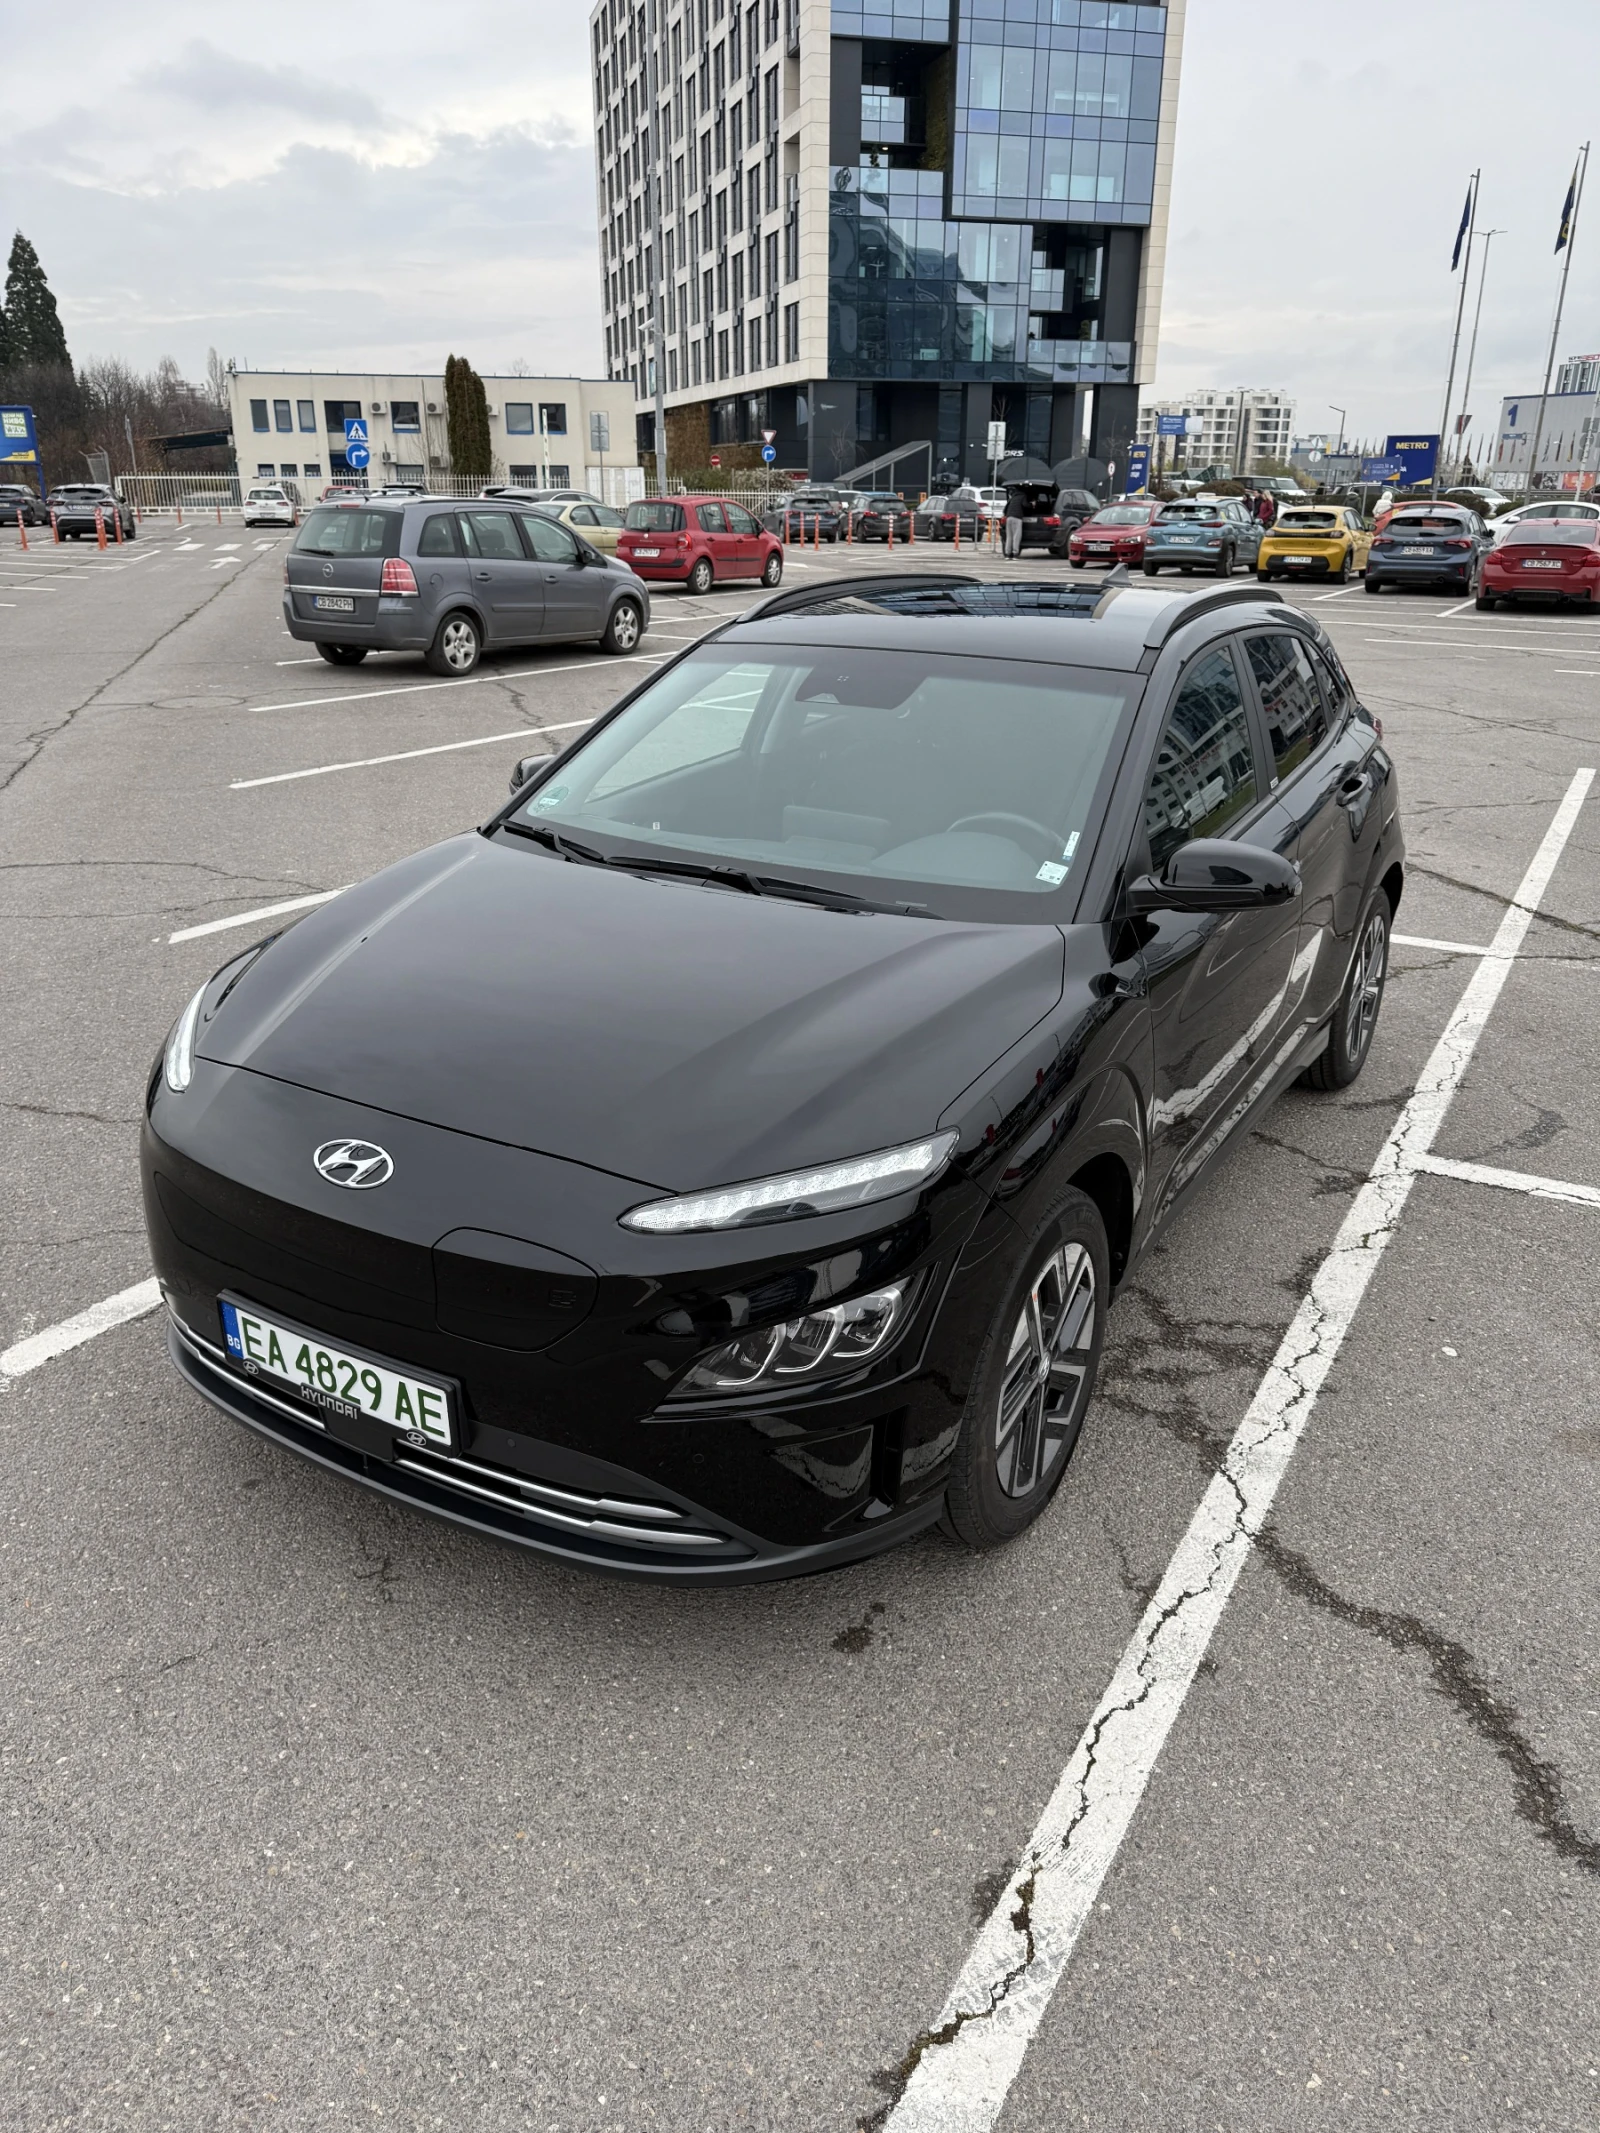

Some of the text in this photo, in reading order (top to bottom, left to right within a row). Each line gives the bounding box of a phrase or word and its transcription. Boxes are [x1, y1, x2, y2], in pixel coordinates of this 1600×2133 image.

[3, 417, 24, 425] НИВО
[1508, 404, 1519, 427] 1
[1396, 442, 1429, 450] METRO
[1526, 560, 1535, 568] CB
[317, 597, 353, 609] CB 2842 PH
[227, 1334, 241, 1350] BG
[241, 1316, 446, 1438] EA 4829 AE
[300, 1386, 358, 1420] HYUNDAI
